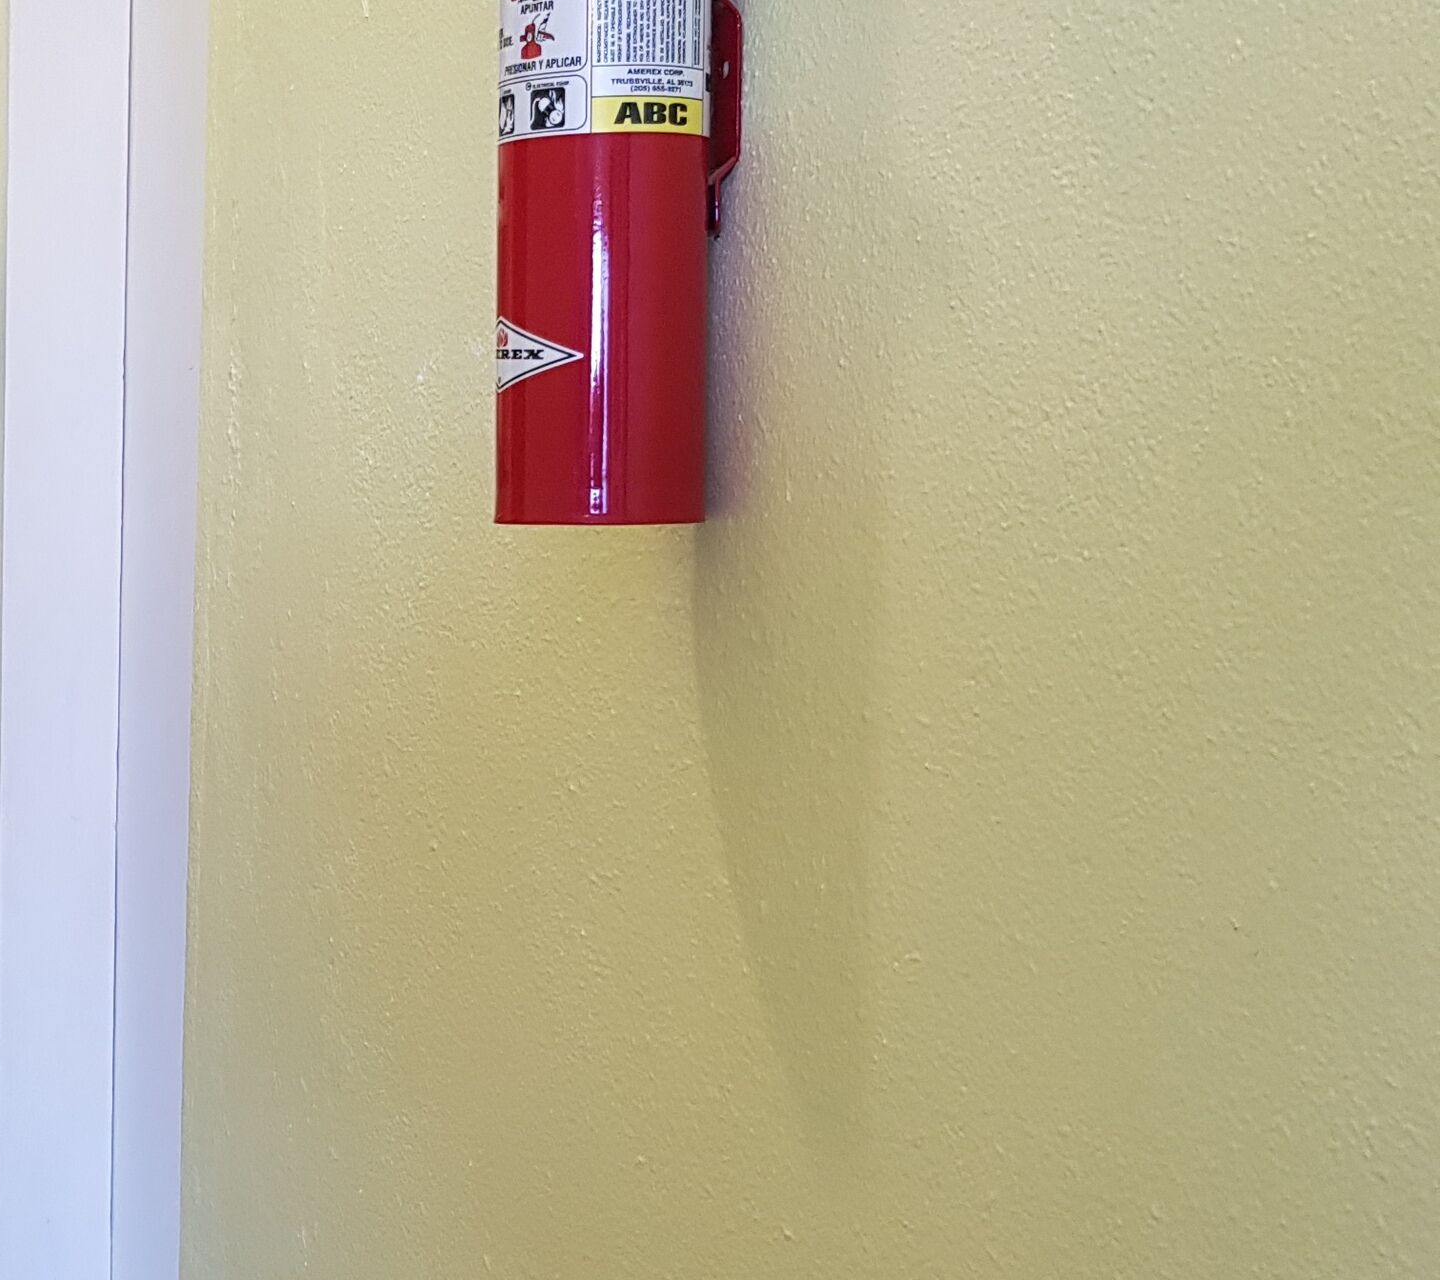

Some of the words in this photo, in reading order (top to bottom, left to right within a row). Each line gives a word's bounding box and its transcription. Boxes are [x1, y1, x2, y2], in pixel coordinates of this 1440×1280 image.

[520, 1, 554, 15] APUNTAR
[538, 60, 544, 70] Y
[545, 56, 582, 70] APLICAR
[613, 102, 688, 126] ABC
